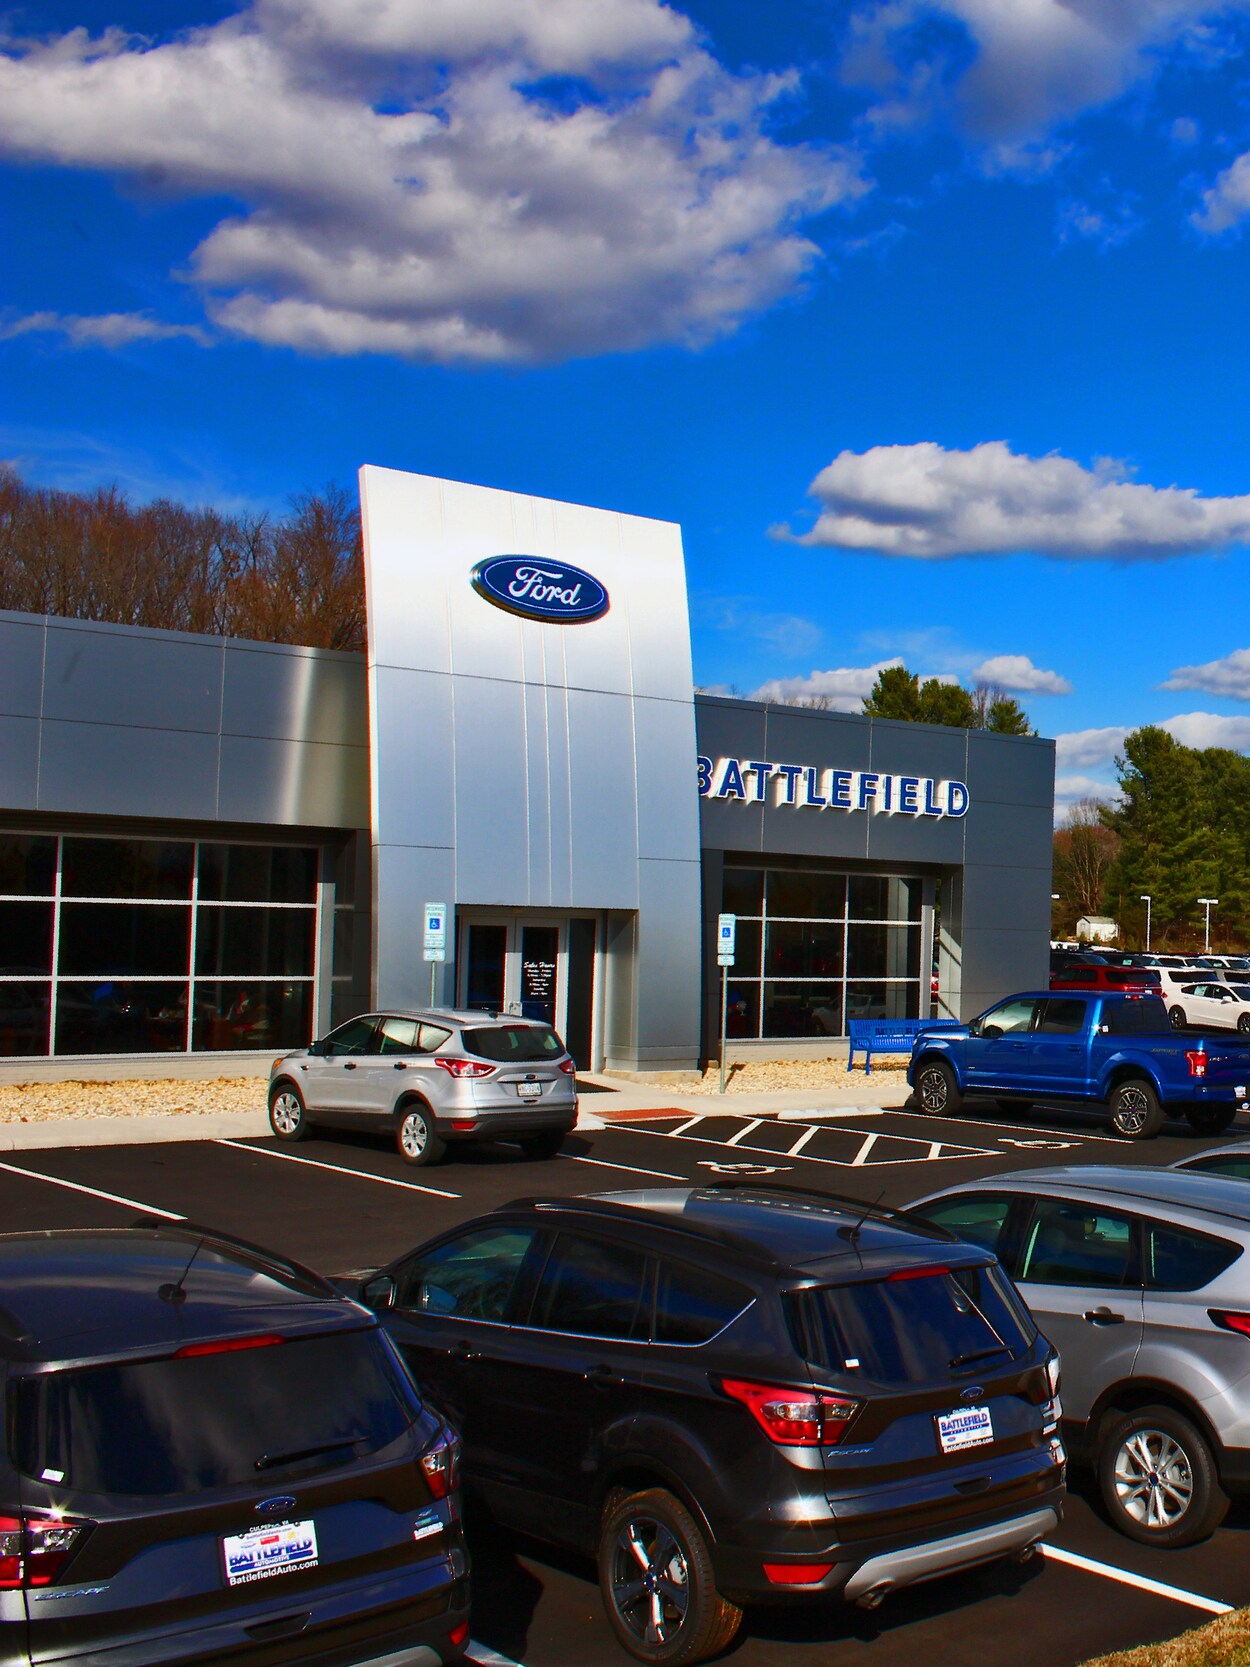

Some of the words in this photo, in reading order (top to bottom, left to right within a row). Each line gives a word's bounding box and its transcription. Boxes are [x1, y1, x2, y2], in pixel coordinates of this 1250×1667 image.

[508, 566, 582, 606] Ford
[698, 756, 970, 818] BATTLEFIELD
[940, 1412, 989, 1432] BATTLEFIELD
[228, 1539, 313, 1567] BATTLEFIELD
[253, 1554, 290, 1567] AUTOMOTIVE
[229, 1559, 319, 1587] BattlefieldAuto.com
